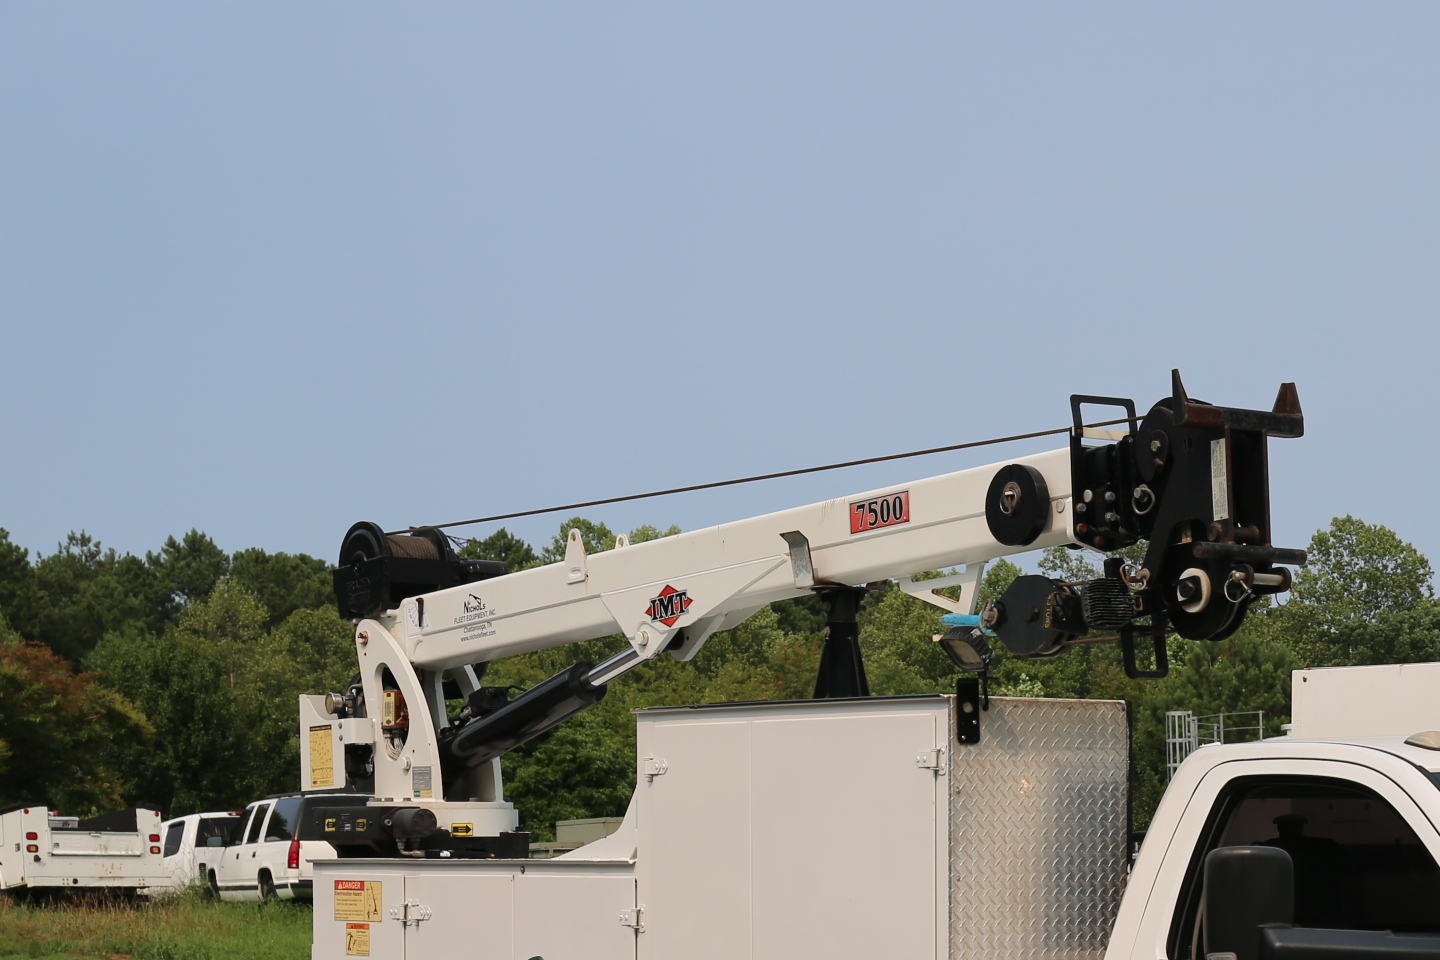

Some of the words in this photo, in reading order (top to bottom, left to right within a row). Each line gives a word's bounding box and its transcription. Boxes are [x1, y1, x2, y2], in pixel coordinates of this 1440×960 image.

[855, 496, 903, 529] 7500
[649, 591, 688, 622] IMT
[453, 615, 466, 624] FLEET
[342, 881, 361, 890] DANGER
